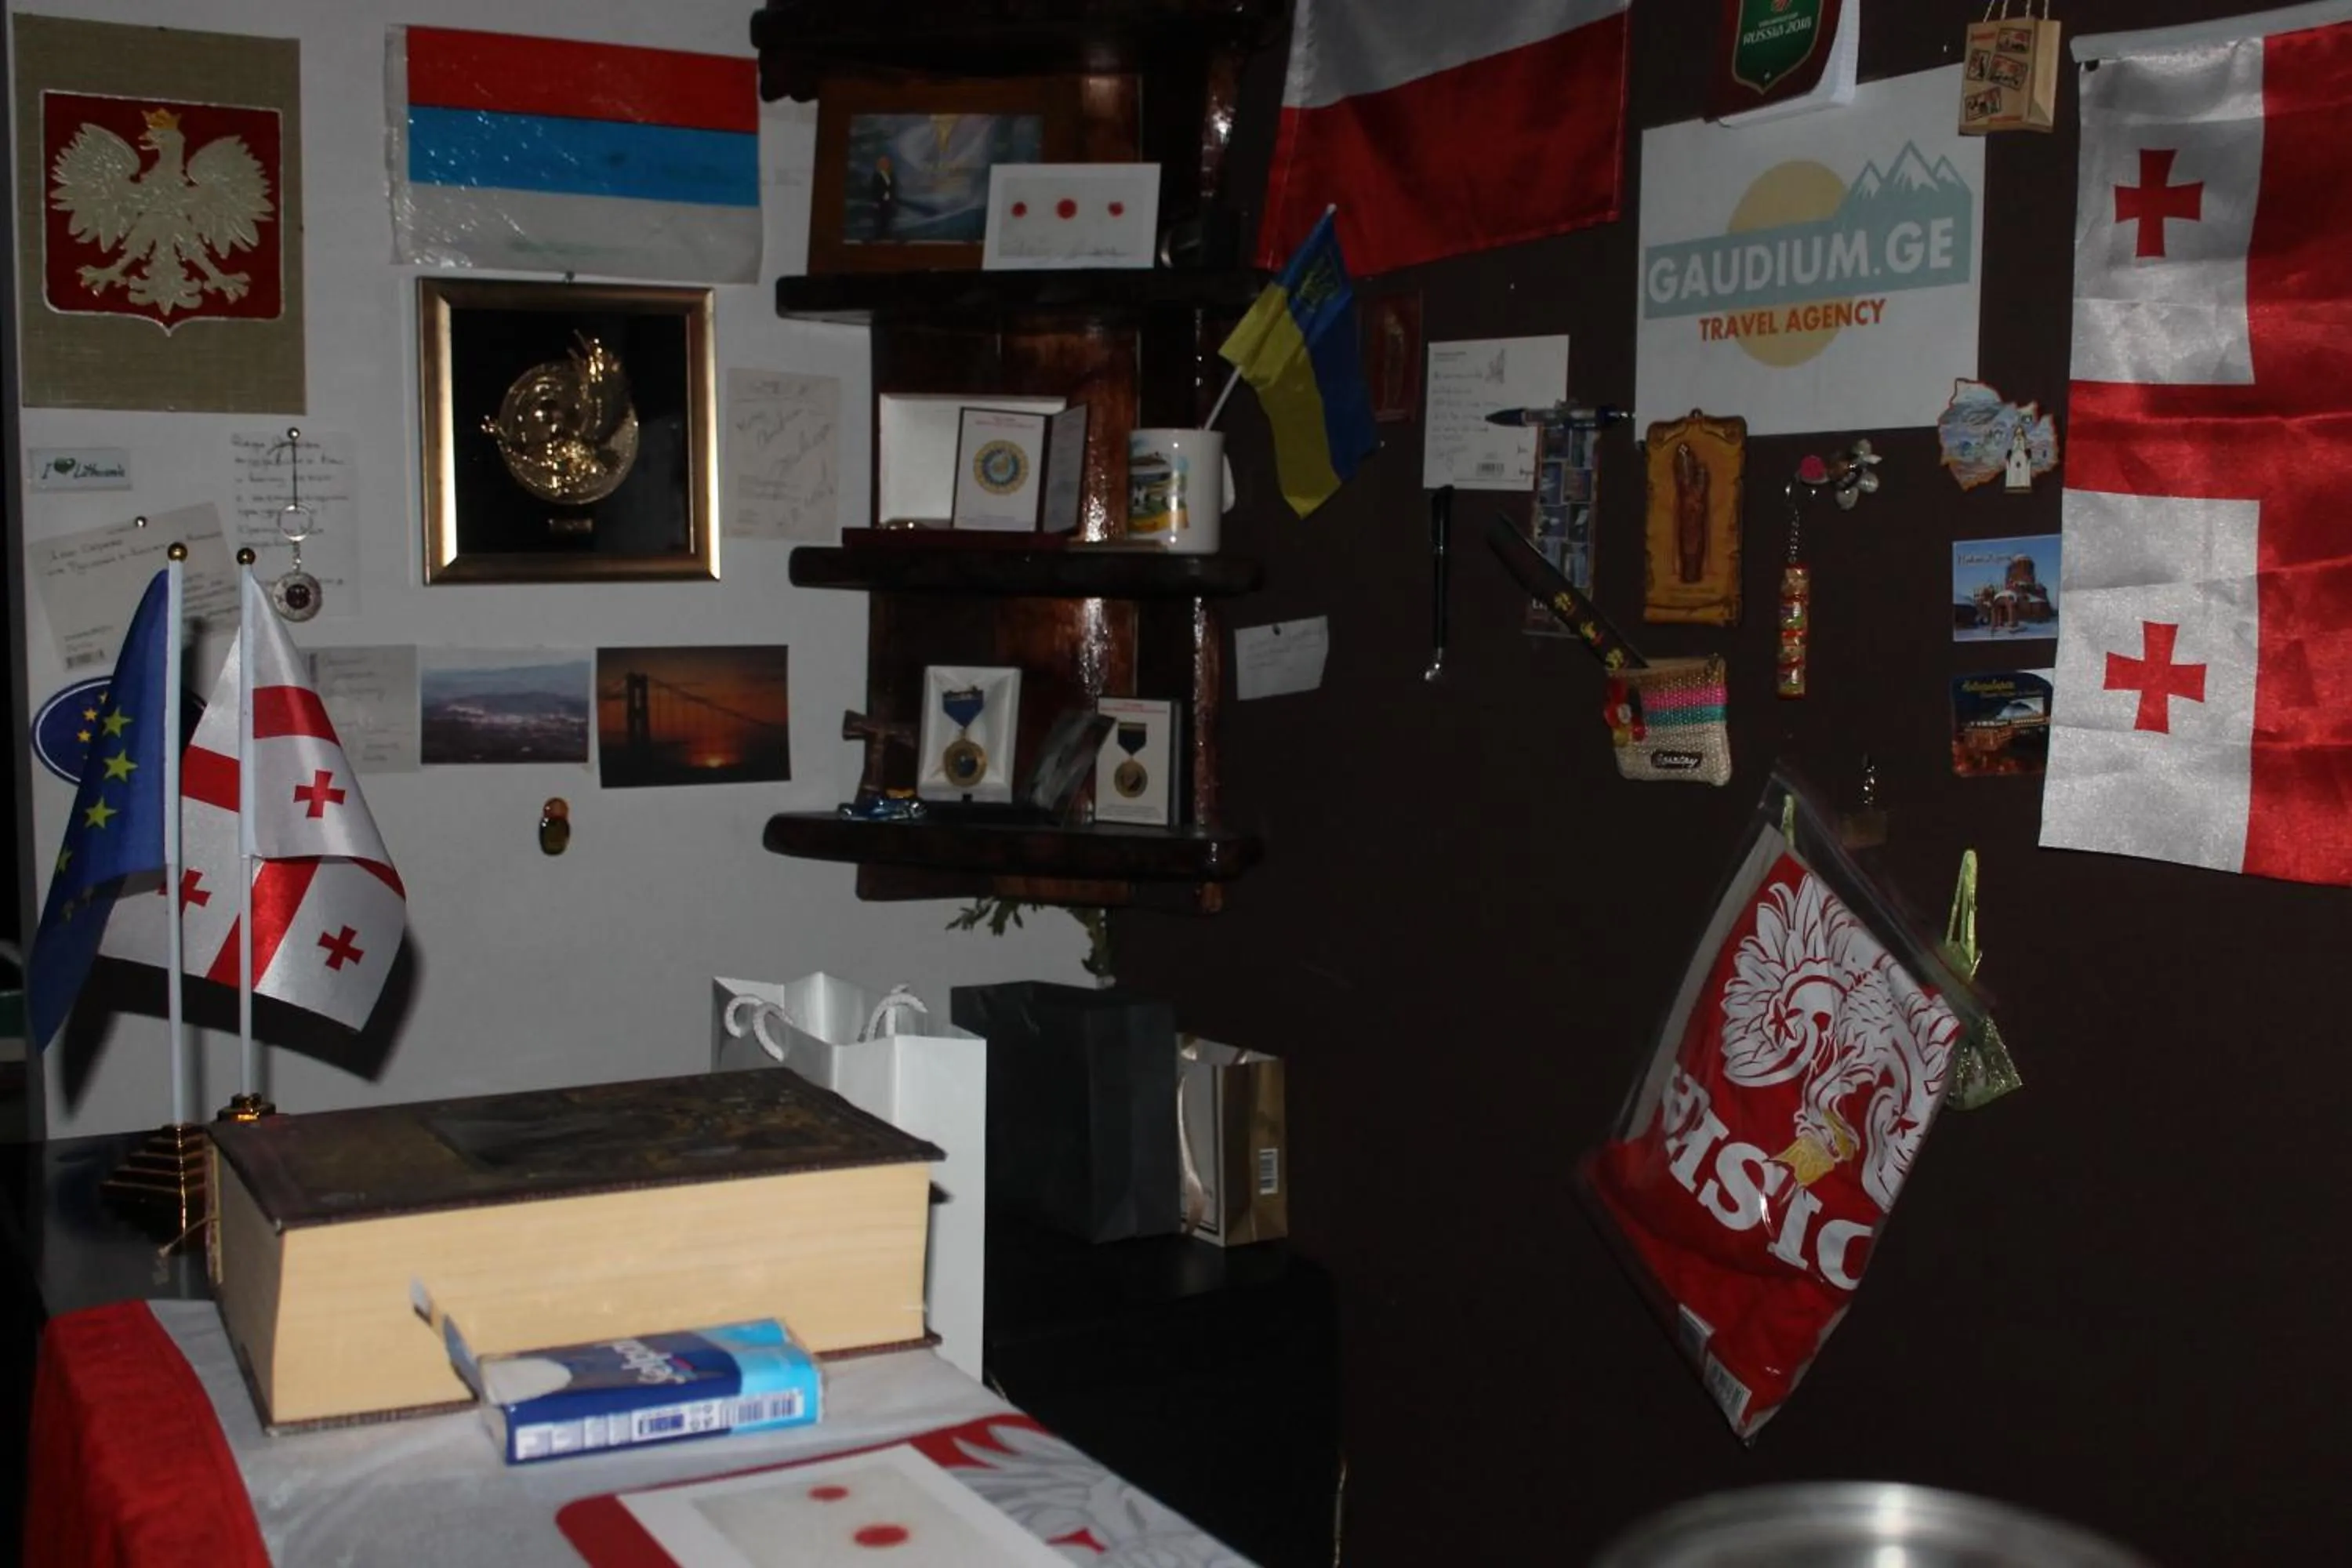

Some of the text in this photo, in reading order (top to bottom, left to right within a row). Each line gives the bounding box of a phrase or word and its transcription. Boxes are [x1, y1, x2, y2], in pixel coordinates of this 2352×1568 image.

[1647, 216, 1955, 305] GAUDIUM.GE
[1700, 298, 1886, 342] TRAVEL AGENCY
